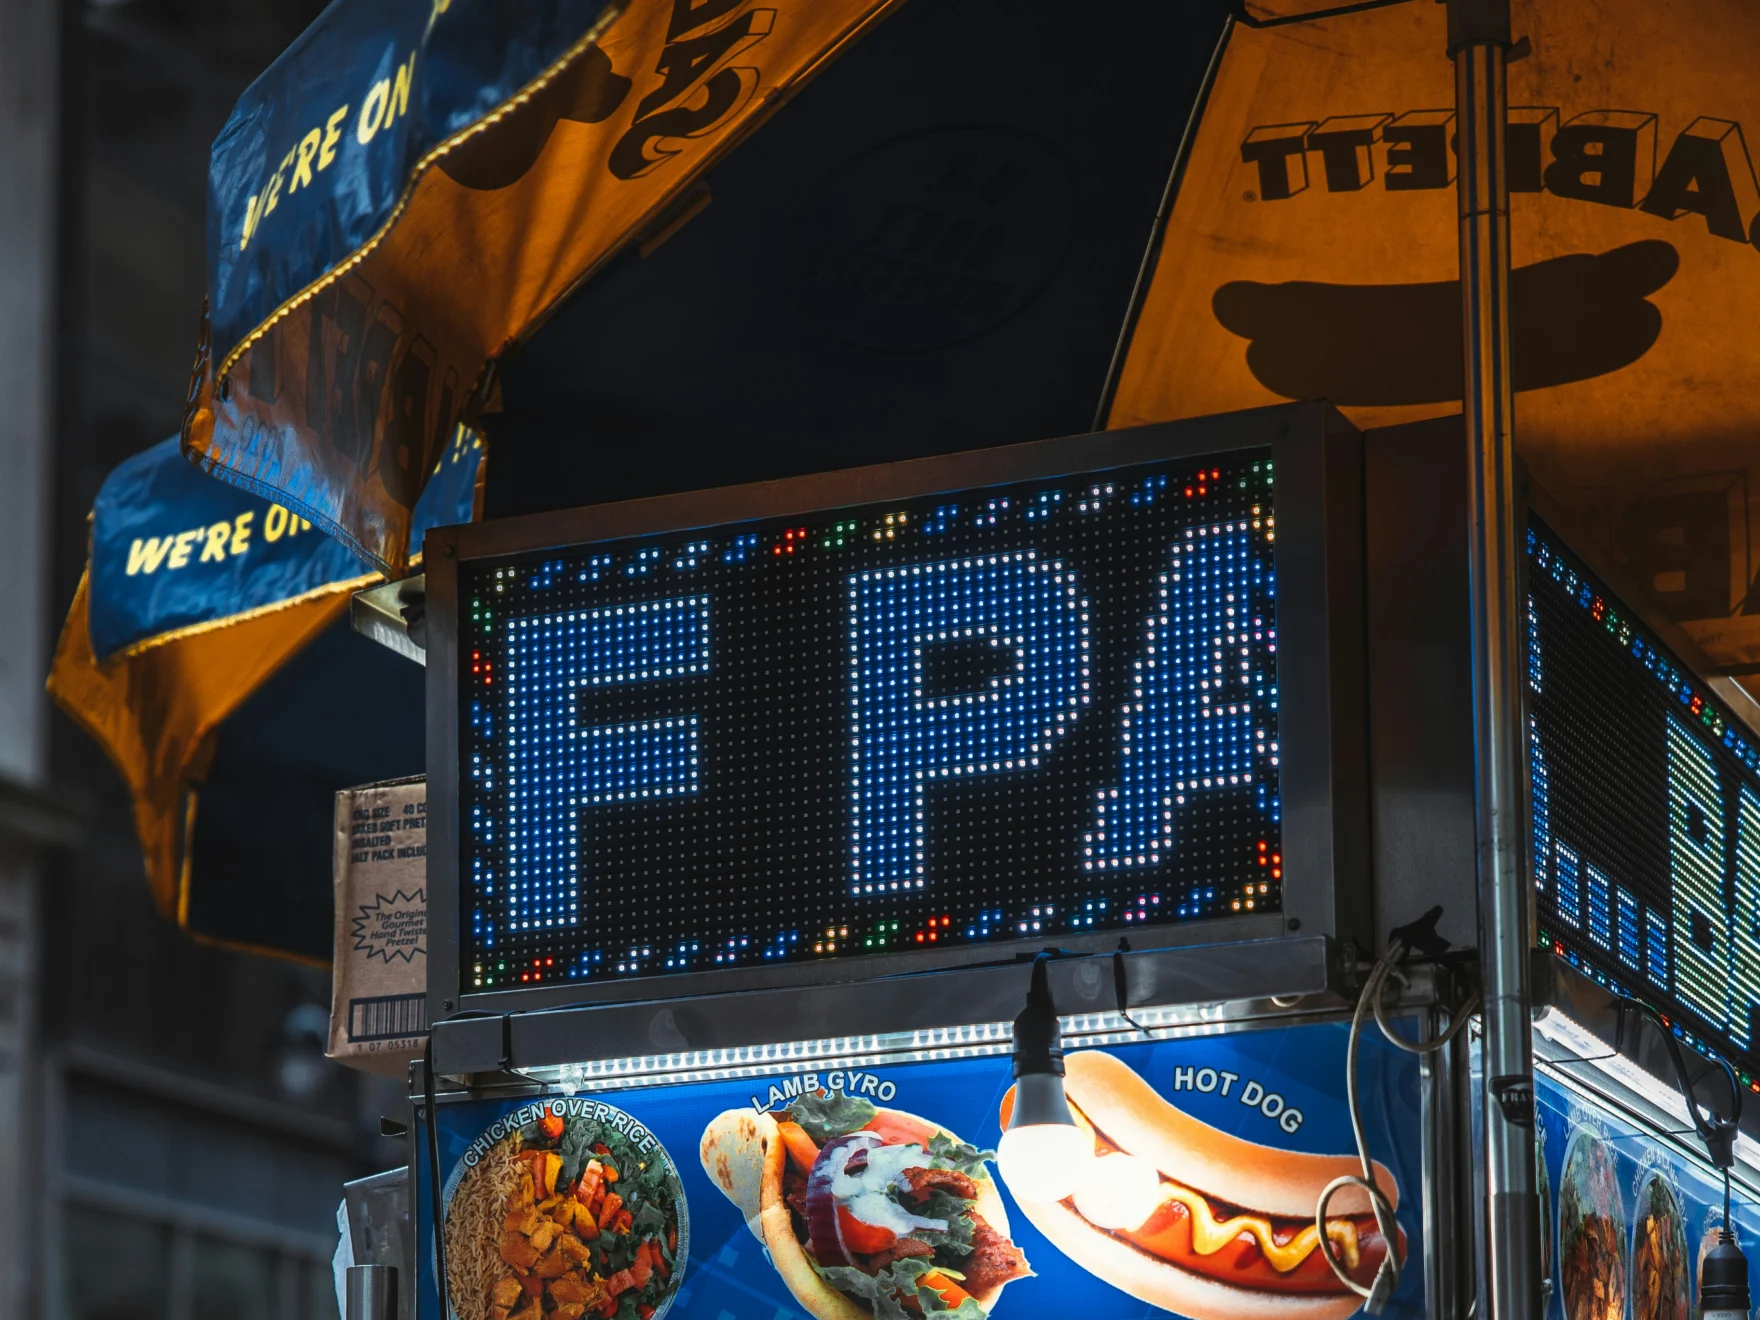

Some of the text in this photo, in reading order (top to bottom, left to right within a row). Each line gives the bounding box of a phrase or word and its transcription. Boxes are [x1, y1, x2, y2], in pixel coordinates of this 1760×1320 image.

[357, 50, 416, 144] ON
[125, 508, 255, 576] WE'RE
[507, 599, 710, 931] F
[372, 806, 390, 819] SIZE
[403, 803, 415, 815] 40
[380, 819, 401, 832] SOFT
[372, 849, 395, 861] PACK
[375, 912, 392, 921] The
[382, 919, 424, 930] Gourmet
[371, 930, 396, 940] Hand
[385, 936, 419, 947] Pretzel
[357, 1038, 419, 1052] 1 07 05318
[750, 1070, 898, 1115] LAMB GYRO
[1173, 1066, 1304, 1134] HOT DOG
[1563, 1105, 1582, 1140] LAMB
[1582, 1104, 1602, 1129] OVER
[463, 1098, 657, 1168] CHICKEN OVER RICE
